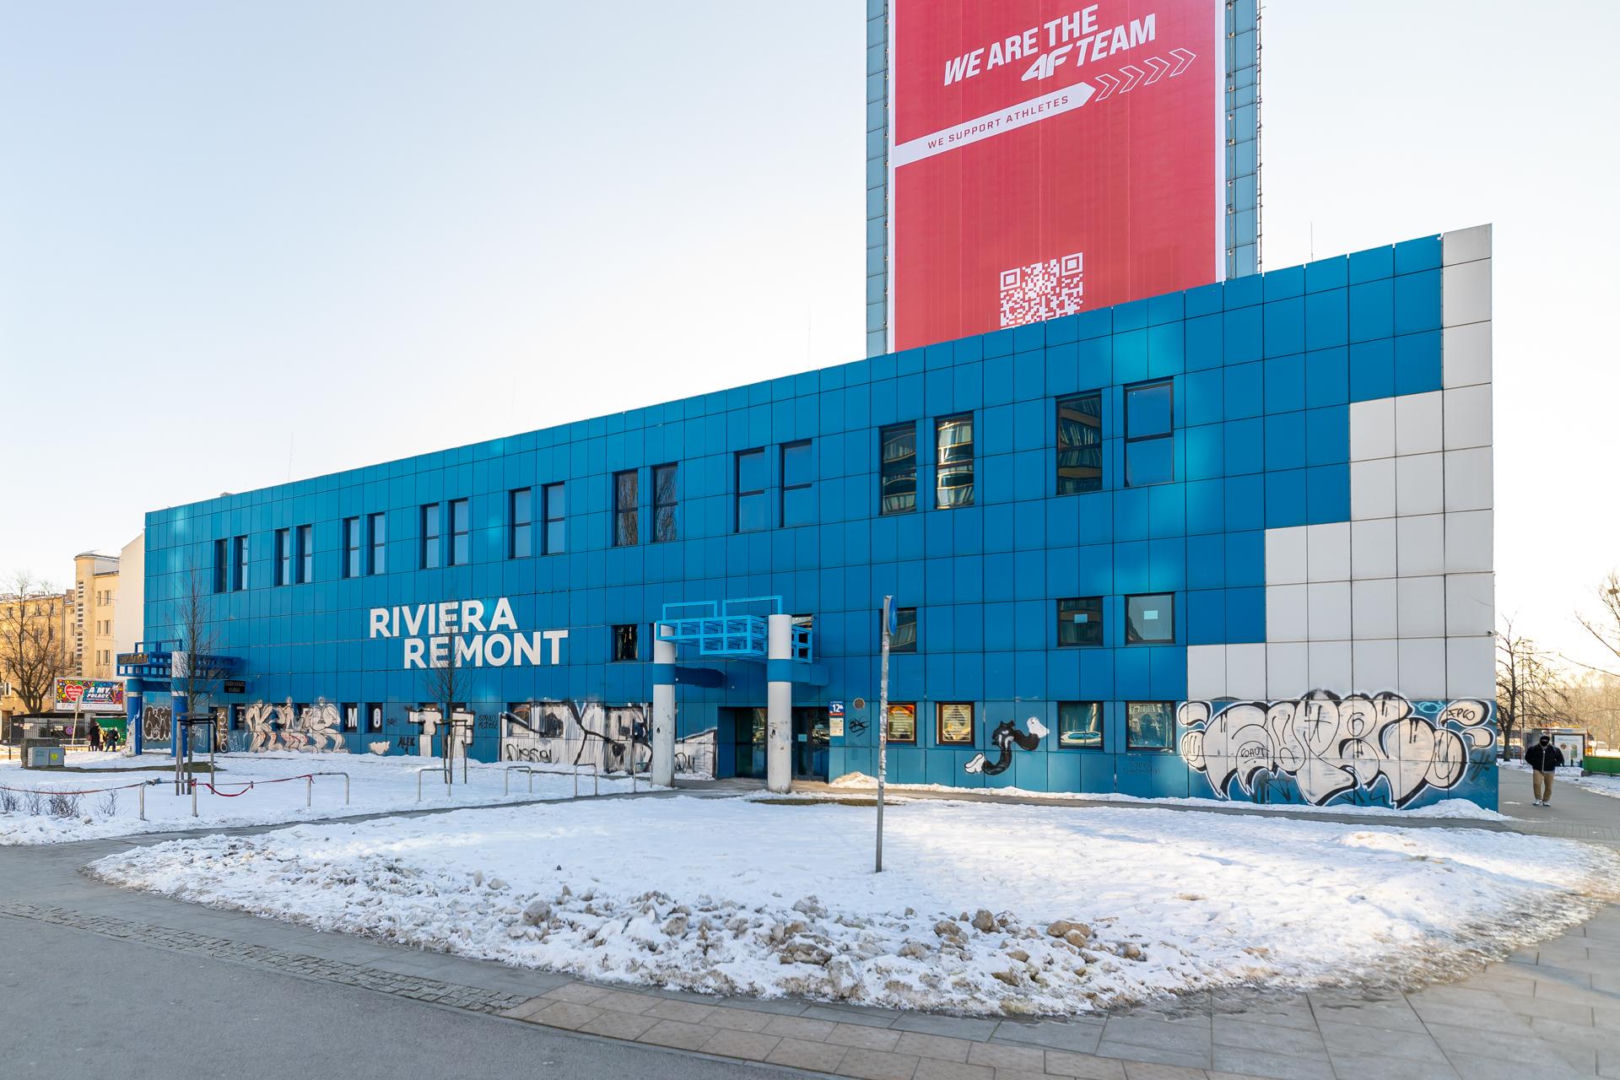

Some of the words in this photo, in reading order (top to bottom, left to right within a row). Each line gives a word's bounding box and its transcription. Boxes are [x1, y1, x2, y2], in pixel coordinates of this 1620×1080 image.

[943, 47, 986, 87] WE
[987, 27, 1039, 71] ARE
[1044, 4, 1099, 44] THE
[1020, 47, 1072, 82] 4F
[1076, 13, 1156, 67] TEAM
[927, 137, 945, 149] WE
[948, 118, 1002, 143] SUPPORT
[1005, 95, 1070, 123] ATHLETES
[369, 597, 518, 639] RIVIERA
[403, 629, 569, 669] REMONT
